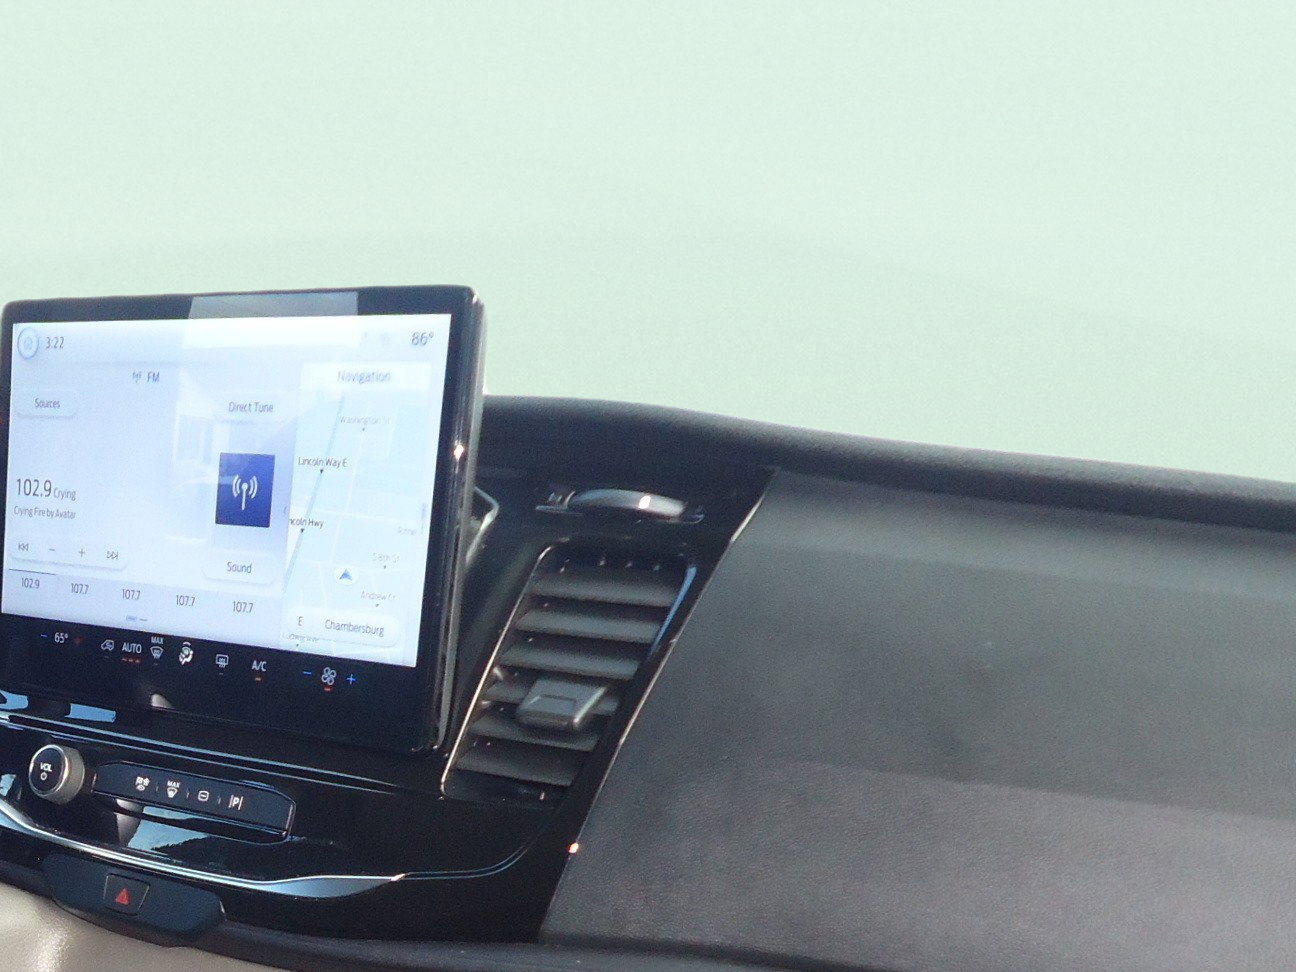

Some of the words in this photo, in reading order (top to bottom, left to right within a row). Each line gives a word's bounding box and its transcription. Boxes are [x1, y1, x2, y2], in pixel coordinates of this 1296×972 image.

[45, 336, 65, 350] 3:22
[147, 371, 160, 383] FM
[336, 369, 391, 385] Navigation
[34, 398, 61, 409] Sources
[228, 401, 252, 413] Direct
[253, 402, 274, 414] Tune
[298, 456, 324, 467] Lincoln
[325, 457, 341, 470] Way
[14, 477, 52, 498] 102.9
[53, 487, 77, 502] Crying
[226, 560, 253, 574] Sound
[21, 577, 40, 590] 102.9
[70, 582, 90, 595] 107.7
[121, 587, 141, 601] 107.7
[175, 594, 196, 607] 107.7
[232, 600, 253, 614] 107.7
[324, 618, 385, 638] Chambersburg
[121, 641, 142, 654] AUTO
[251, 660, 267, 673] A/C
[40, 762, 52, 773] VOL
[166, 780, 180, 789] MAX
